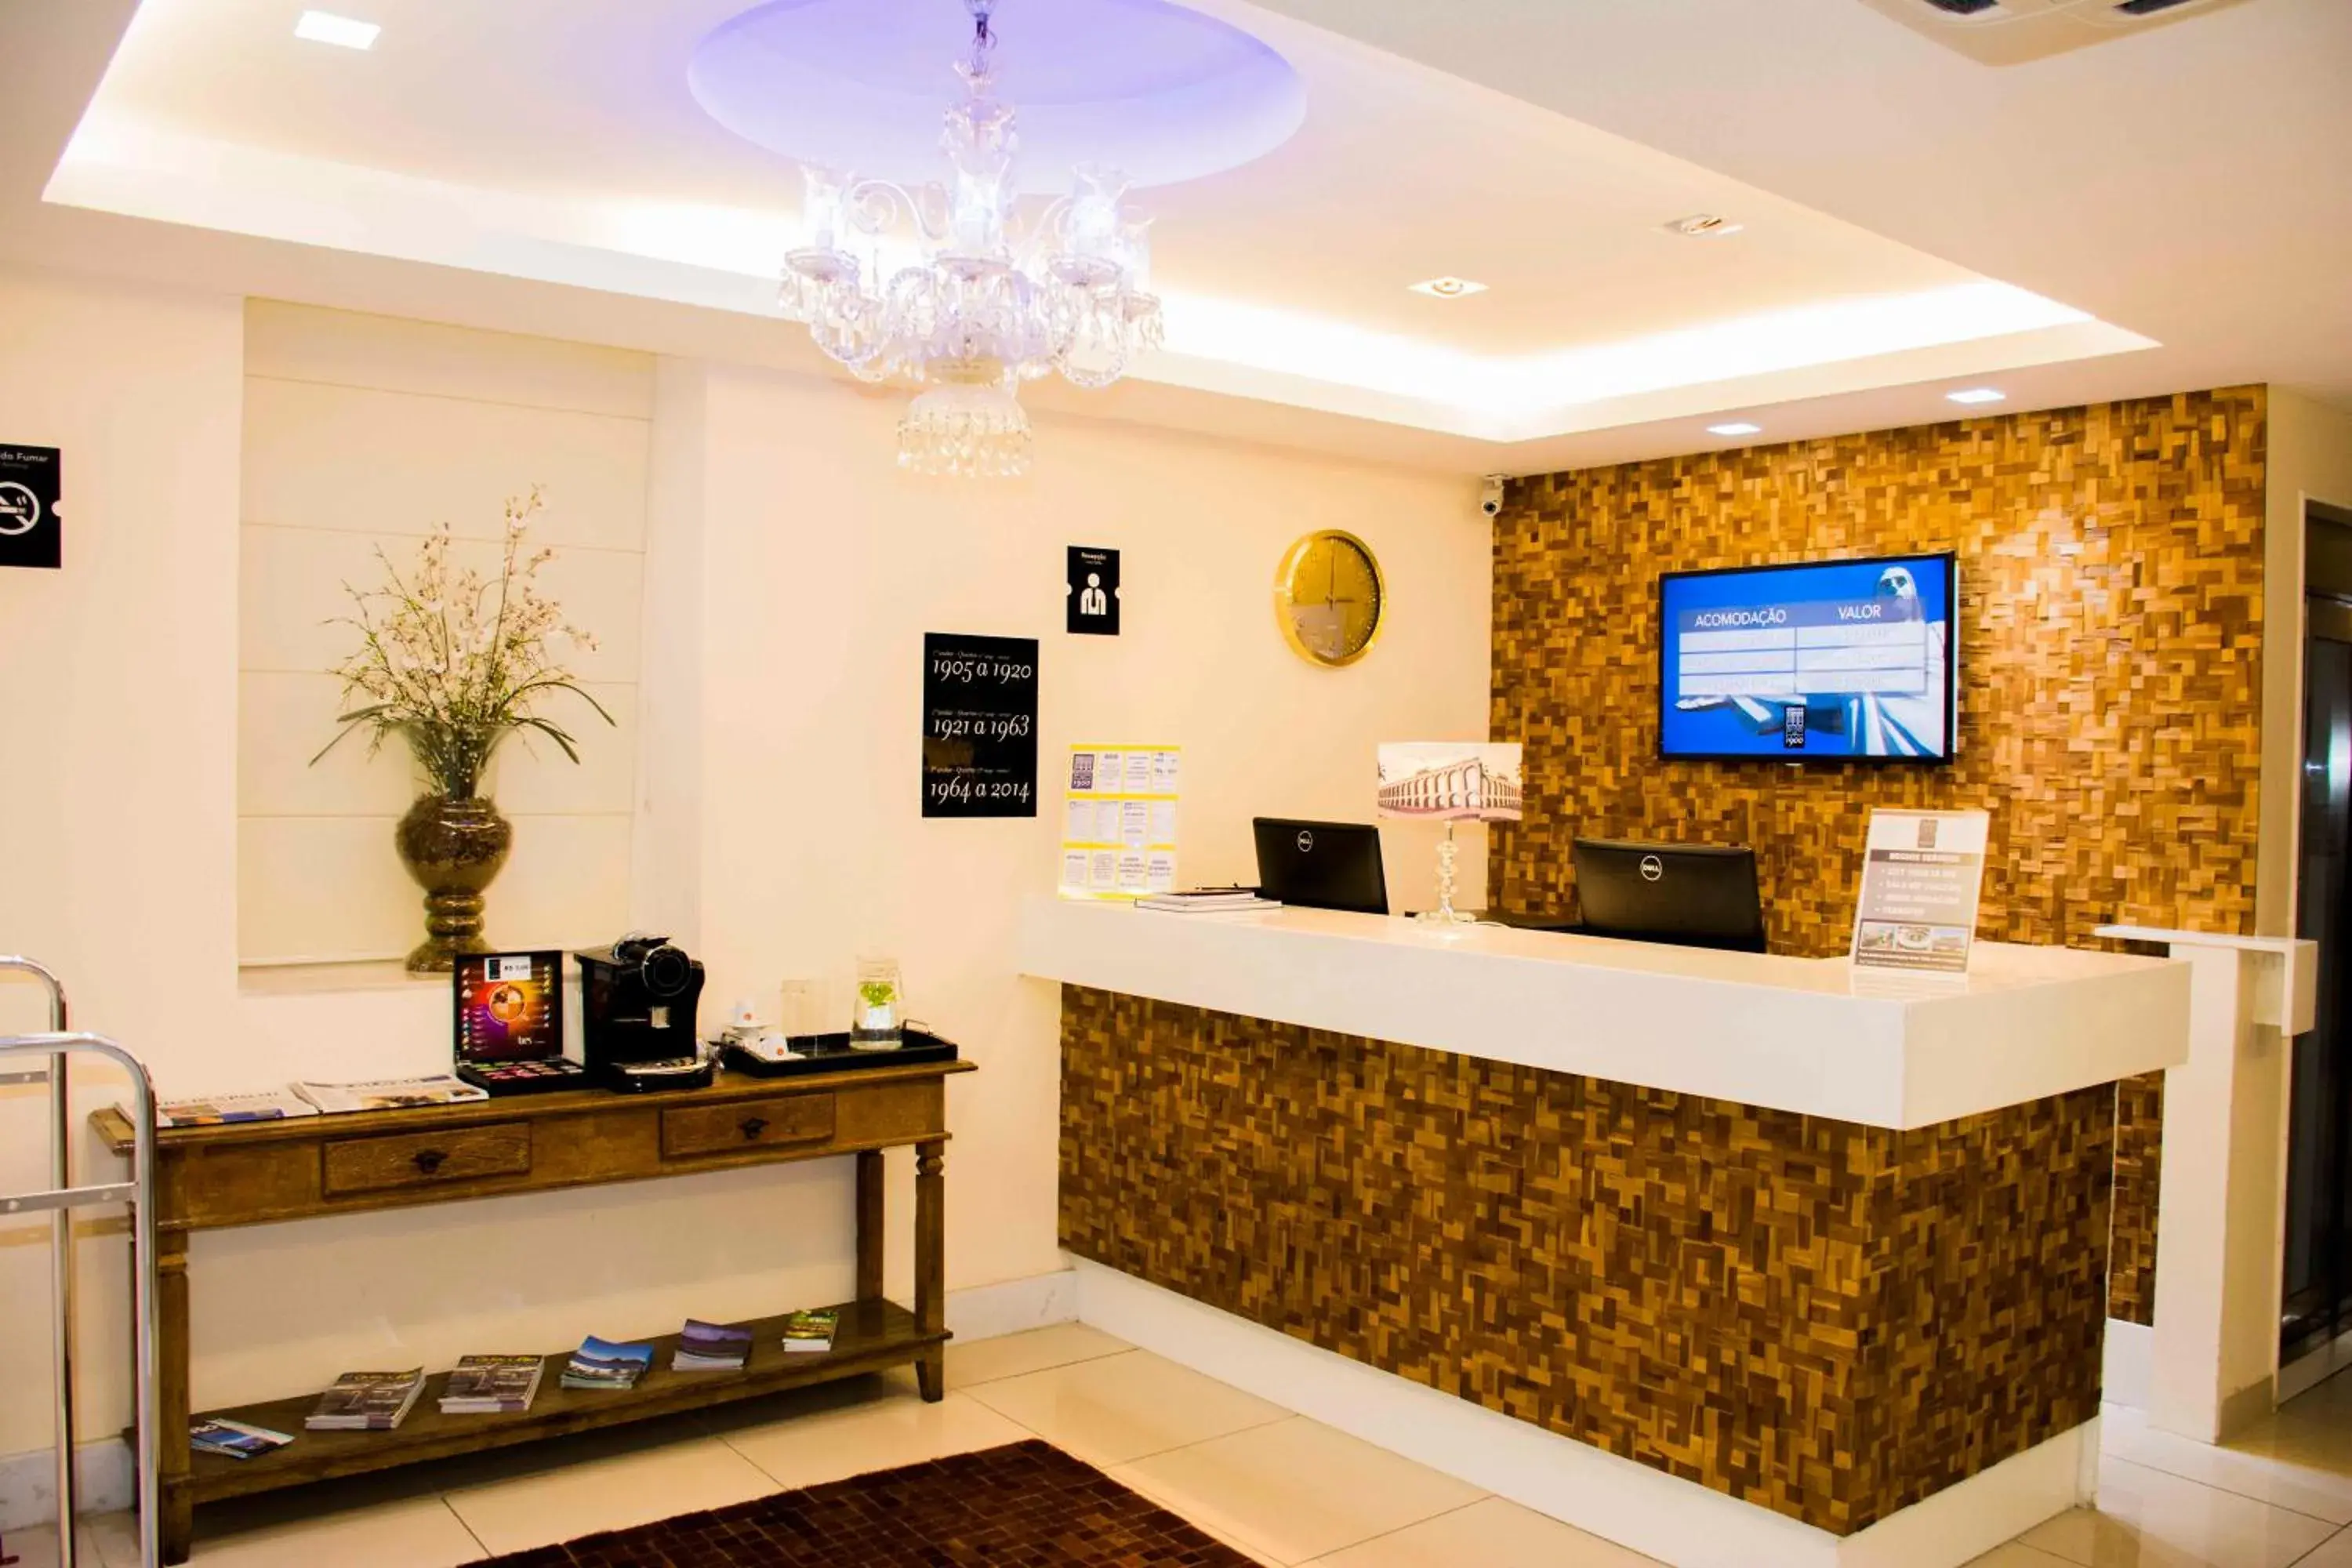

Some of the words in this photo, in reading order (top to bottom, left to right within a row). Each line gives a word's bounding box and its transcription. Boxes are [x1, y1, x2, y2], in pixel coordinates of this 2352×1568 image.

[16, 452, 48, 462] Fumar
[1694, 608, 1786, 627] ACOMODAÇÃO
[1838, 604, 1882, 620] VALOR
[933, 659, 974, 683] 1905
[976, 662, 988, 677] a
[993, 662, 1032, 684] 1920
[934, 719, 969, 741] 1921
[974, 720, 986, 735] a
[991, 714, 1029, 742] 1963
[931, 776, 971, 805] 1964
[975, 782, 987, 797] a
[991, 782, 1030, 804] 2014
